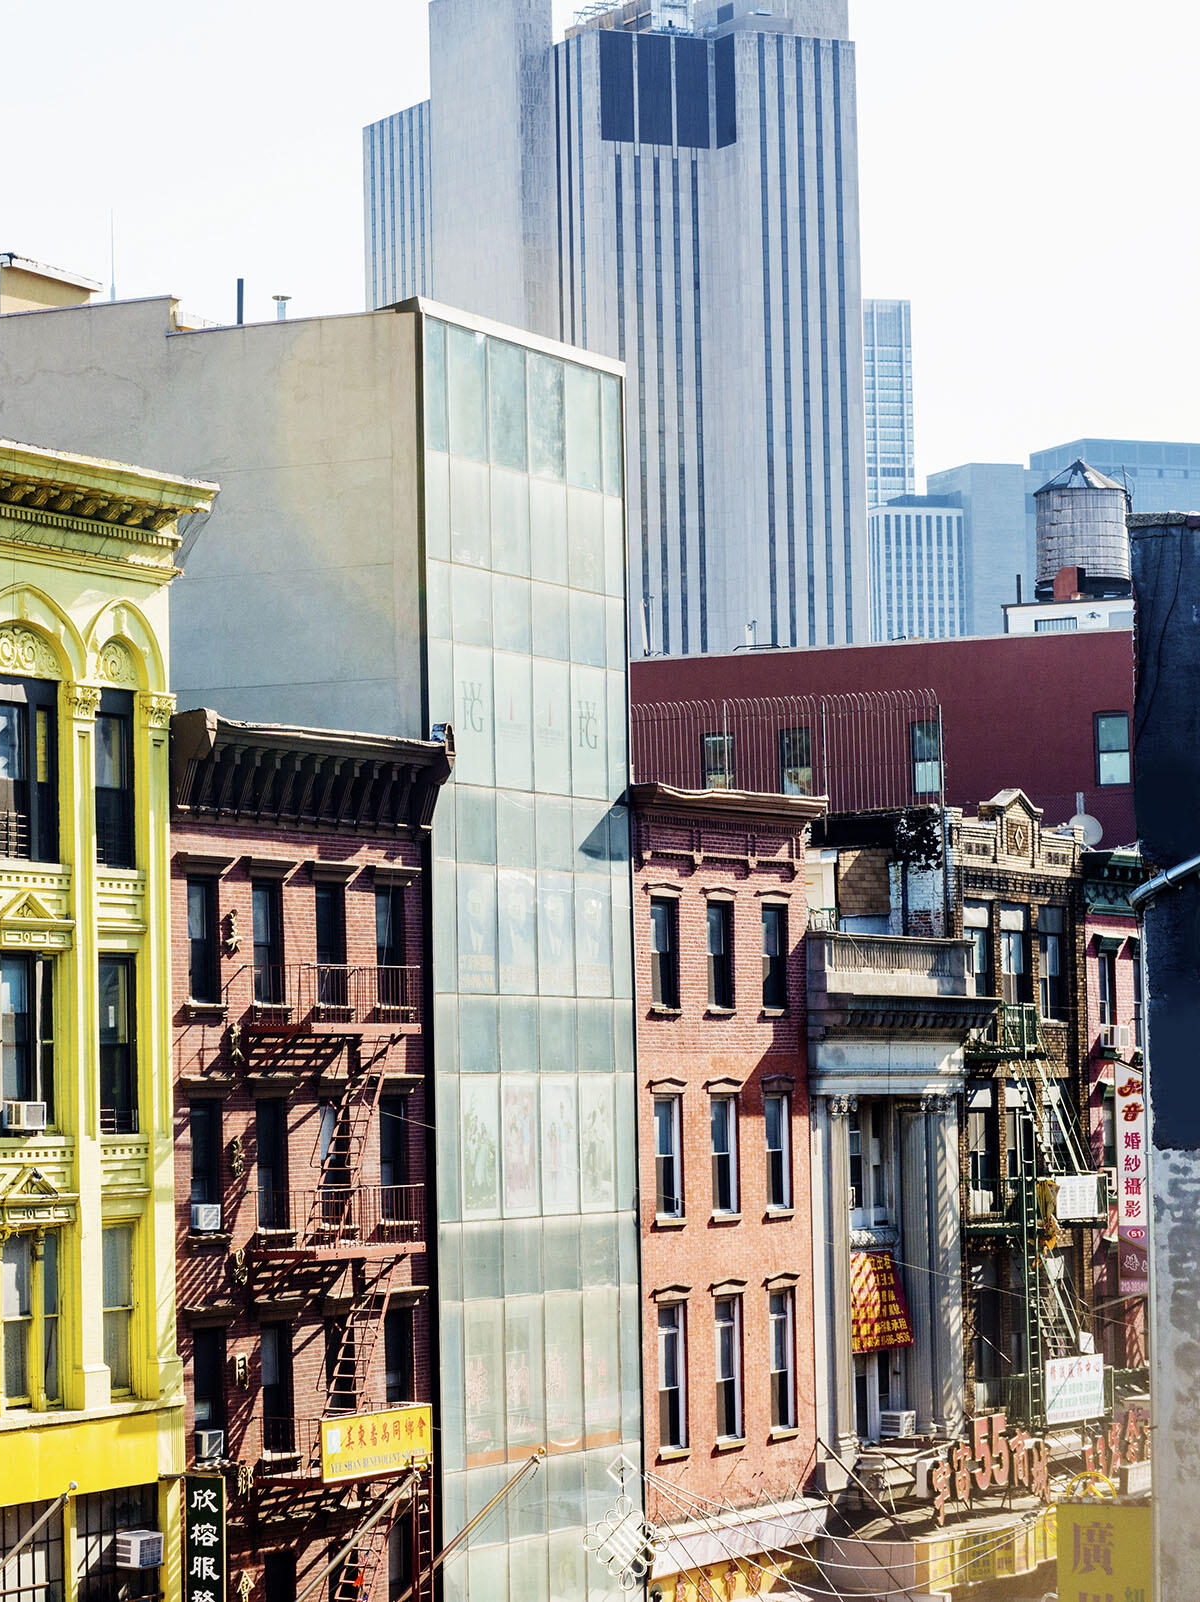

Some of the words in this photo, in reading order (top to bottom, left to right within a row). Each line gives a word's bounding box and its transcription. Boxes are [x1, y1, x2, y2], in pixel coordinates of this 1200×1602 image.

[344, 1457, 362, 1472] SHAN
[362, 1451, 401, 1469] BENEVOLENT
[1072, 1521, 1115, 1602] 廣
